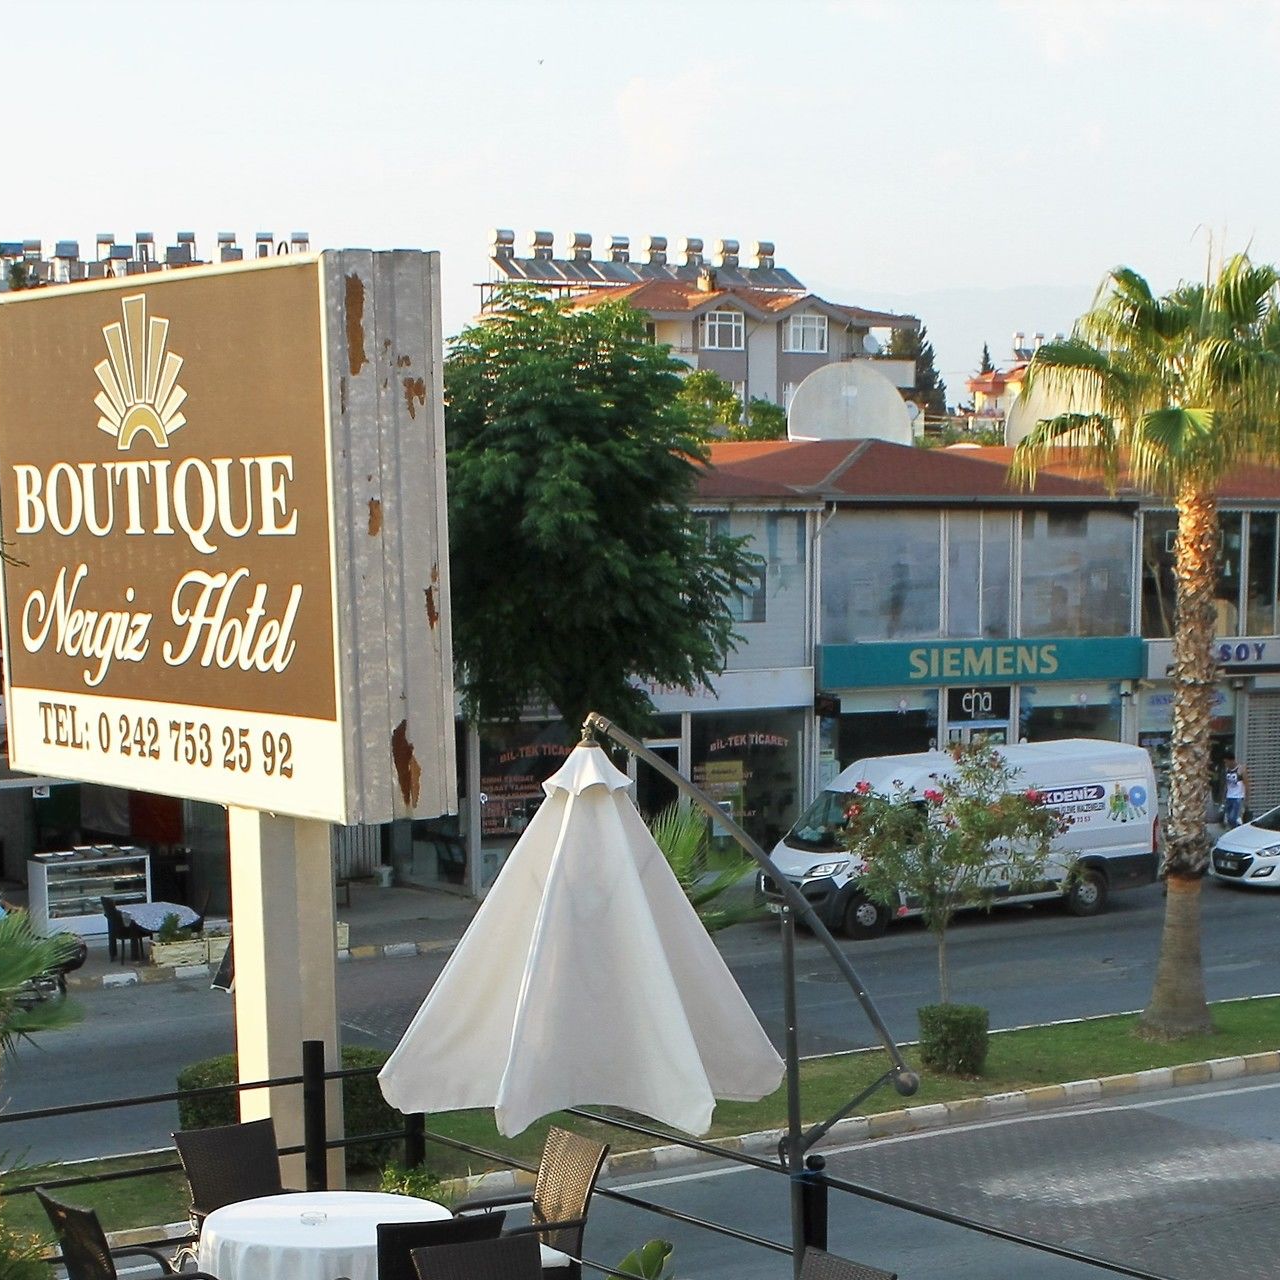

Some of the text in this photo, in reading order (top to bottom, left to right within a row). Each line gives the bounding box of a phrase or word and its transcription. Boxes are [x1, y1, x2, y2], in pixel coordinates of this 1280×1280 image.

[13, 455, 299, 554] BOUTIQUE
[22, 563, 303, 687] Nergiz Hotel
[1219, 642, 1266, 662] SOY
[909, 644, 1059, 679] SIEMENS
[39, 701, 294, 780] TEL: 0 242 753 25 92
[1041, 786, 1098, 803] KDENİZ
